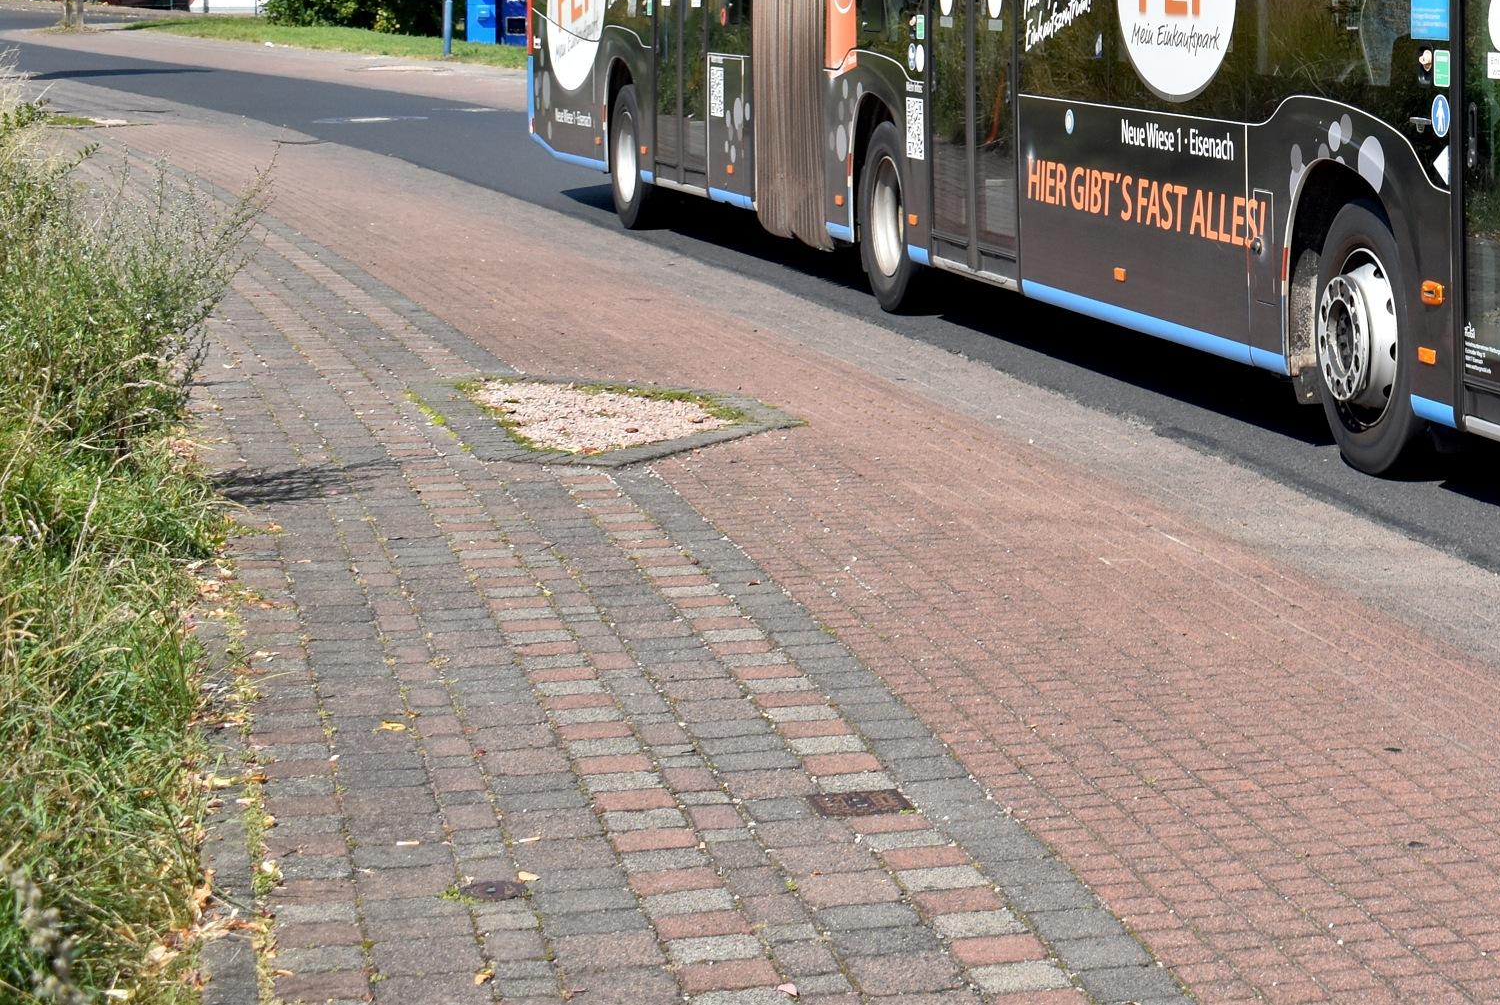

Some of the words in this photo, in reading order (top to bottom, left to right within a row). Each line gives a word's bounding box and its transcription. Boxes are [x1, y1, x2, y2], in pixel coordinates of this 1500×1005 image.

[1131, 22, 1154, 46] Mein
[1156, 23, 1221, 57] Einkaufspark
[1121, 118, 1146, 147] Neue
[1146, 122, 1175, 151] Wiese
[1176, 127, 1182, 152] 1
[1189, 128, 1234, 161] Eisenach
[1027, 158, 1067, 207] HIER
[1136, 177, 1188, 233] FAST
[1189, 189, 1267, 248] ALLES!
